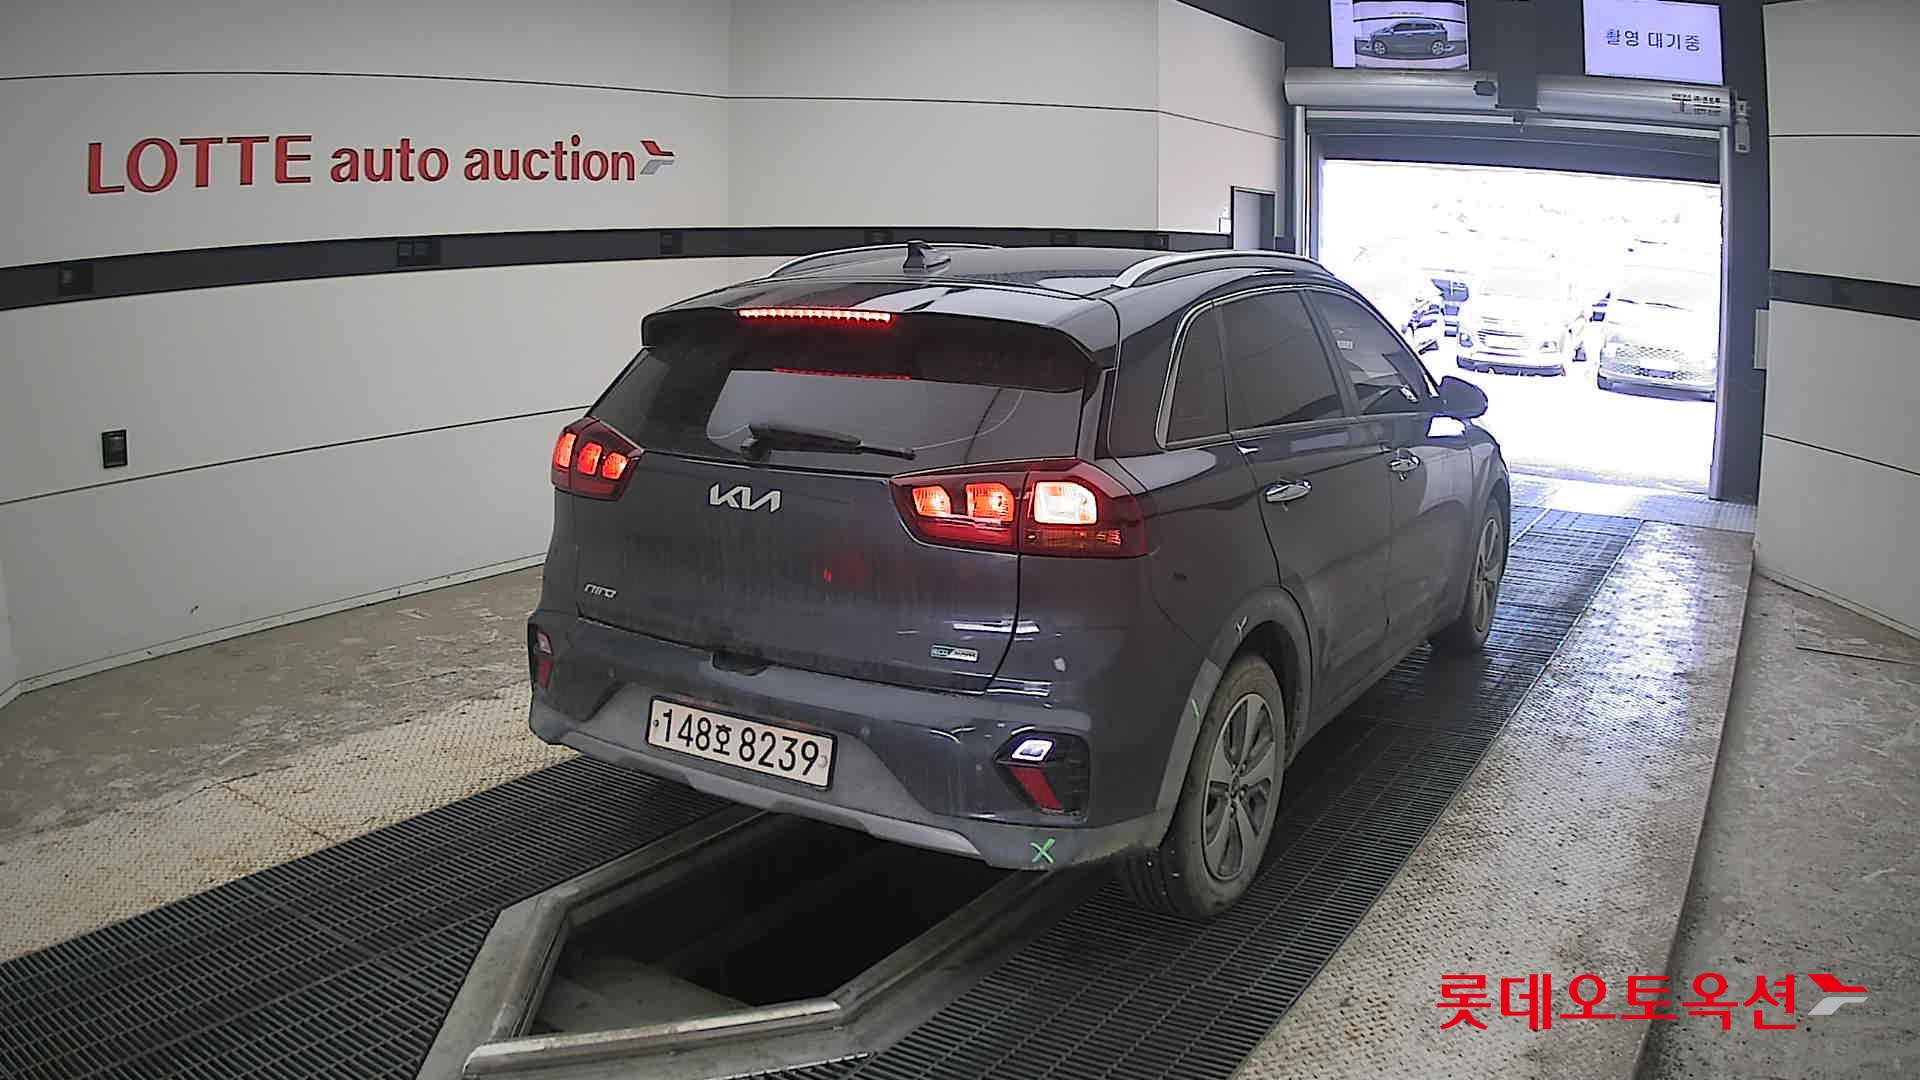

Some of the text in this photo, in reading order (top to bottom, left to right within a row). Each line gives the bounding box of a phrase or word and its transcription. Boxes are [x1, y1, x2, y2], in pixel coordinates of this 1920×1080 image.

[87, 134, 636, 194] LOTTE auto auction
